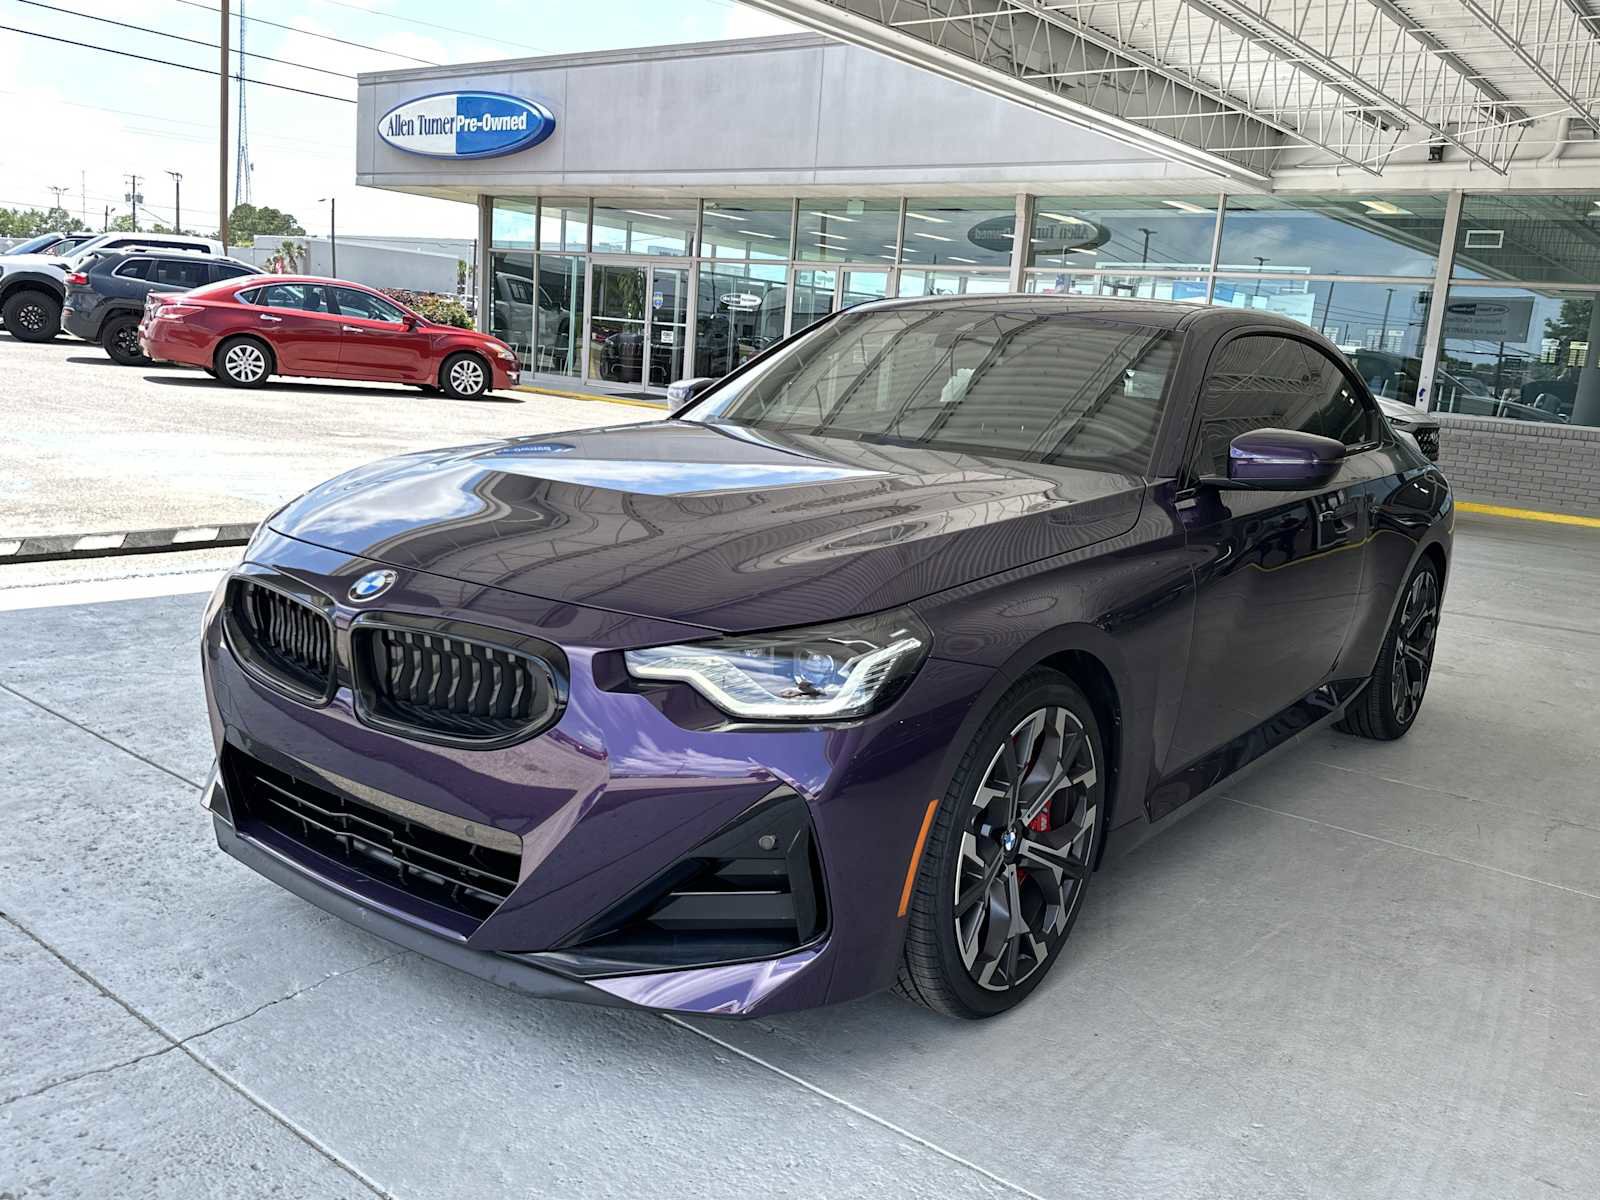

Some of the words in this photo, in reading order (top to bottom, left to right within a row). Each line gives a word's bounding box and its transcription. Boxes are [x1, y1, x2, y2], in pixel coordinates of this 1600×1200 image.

[387, 114, 414, 137] Allen
[418, 114, 455, 136] Turner
[456, 111, 528, 132] Pre-Owned
